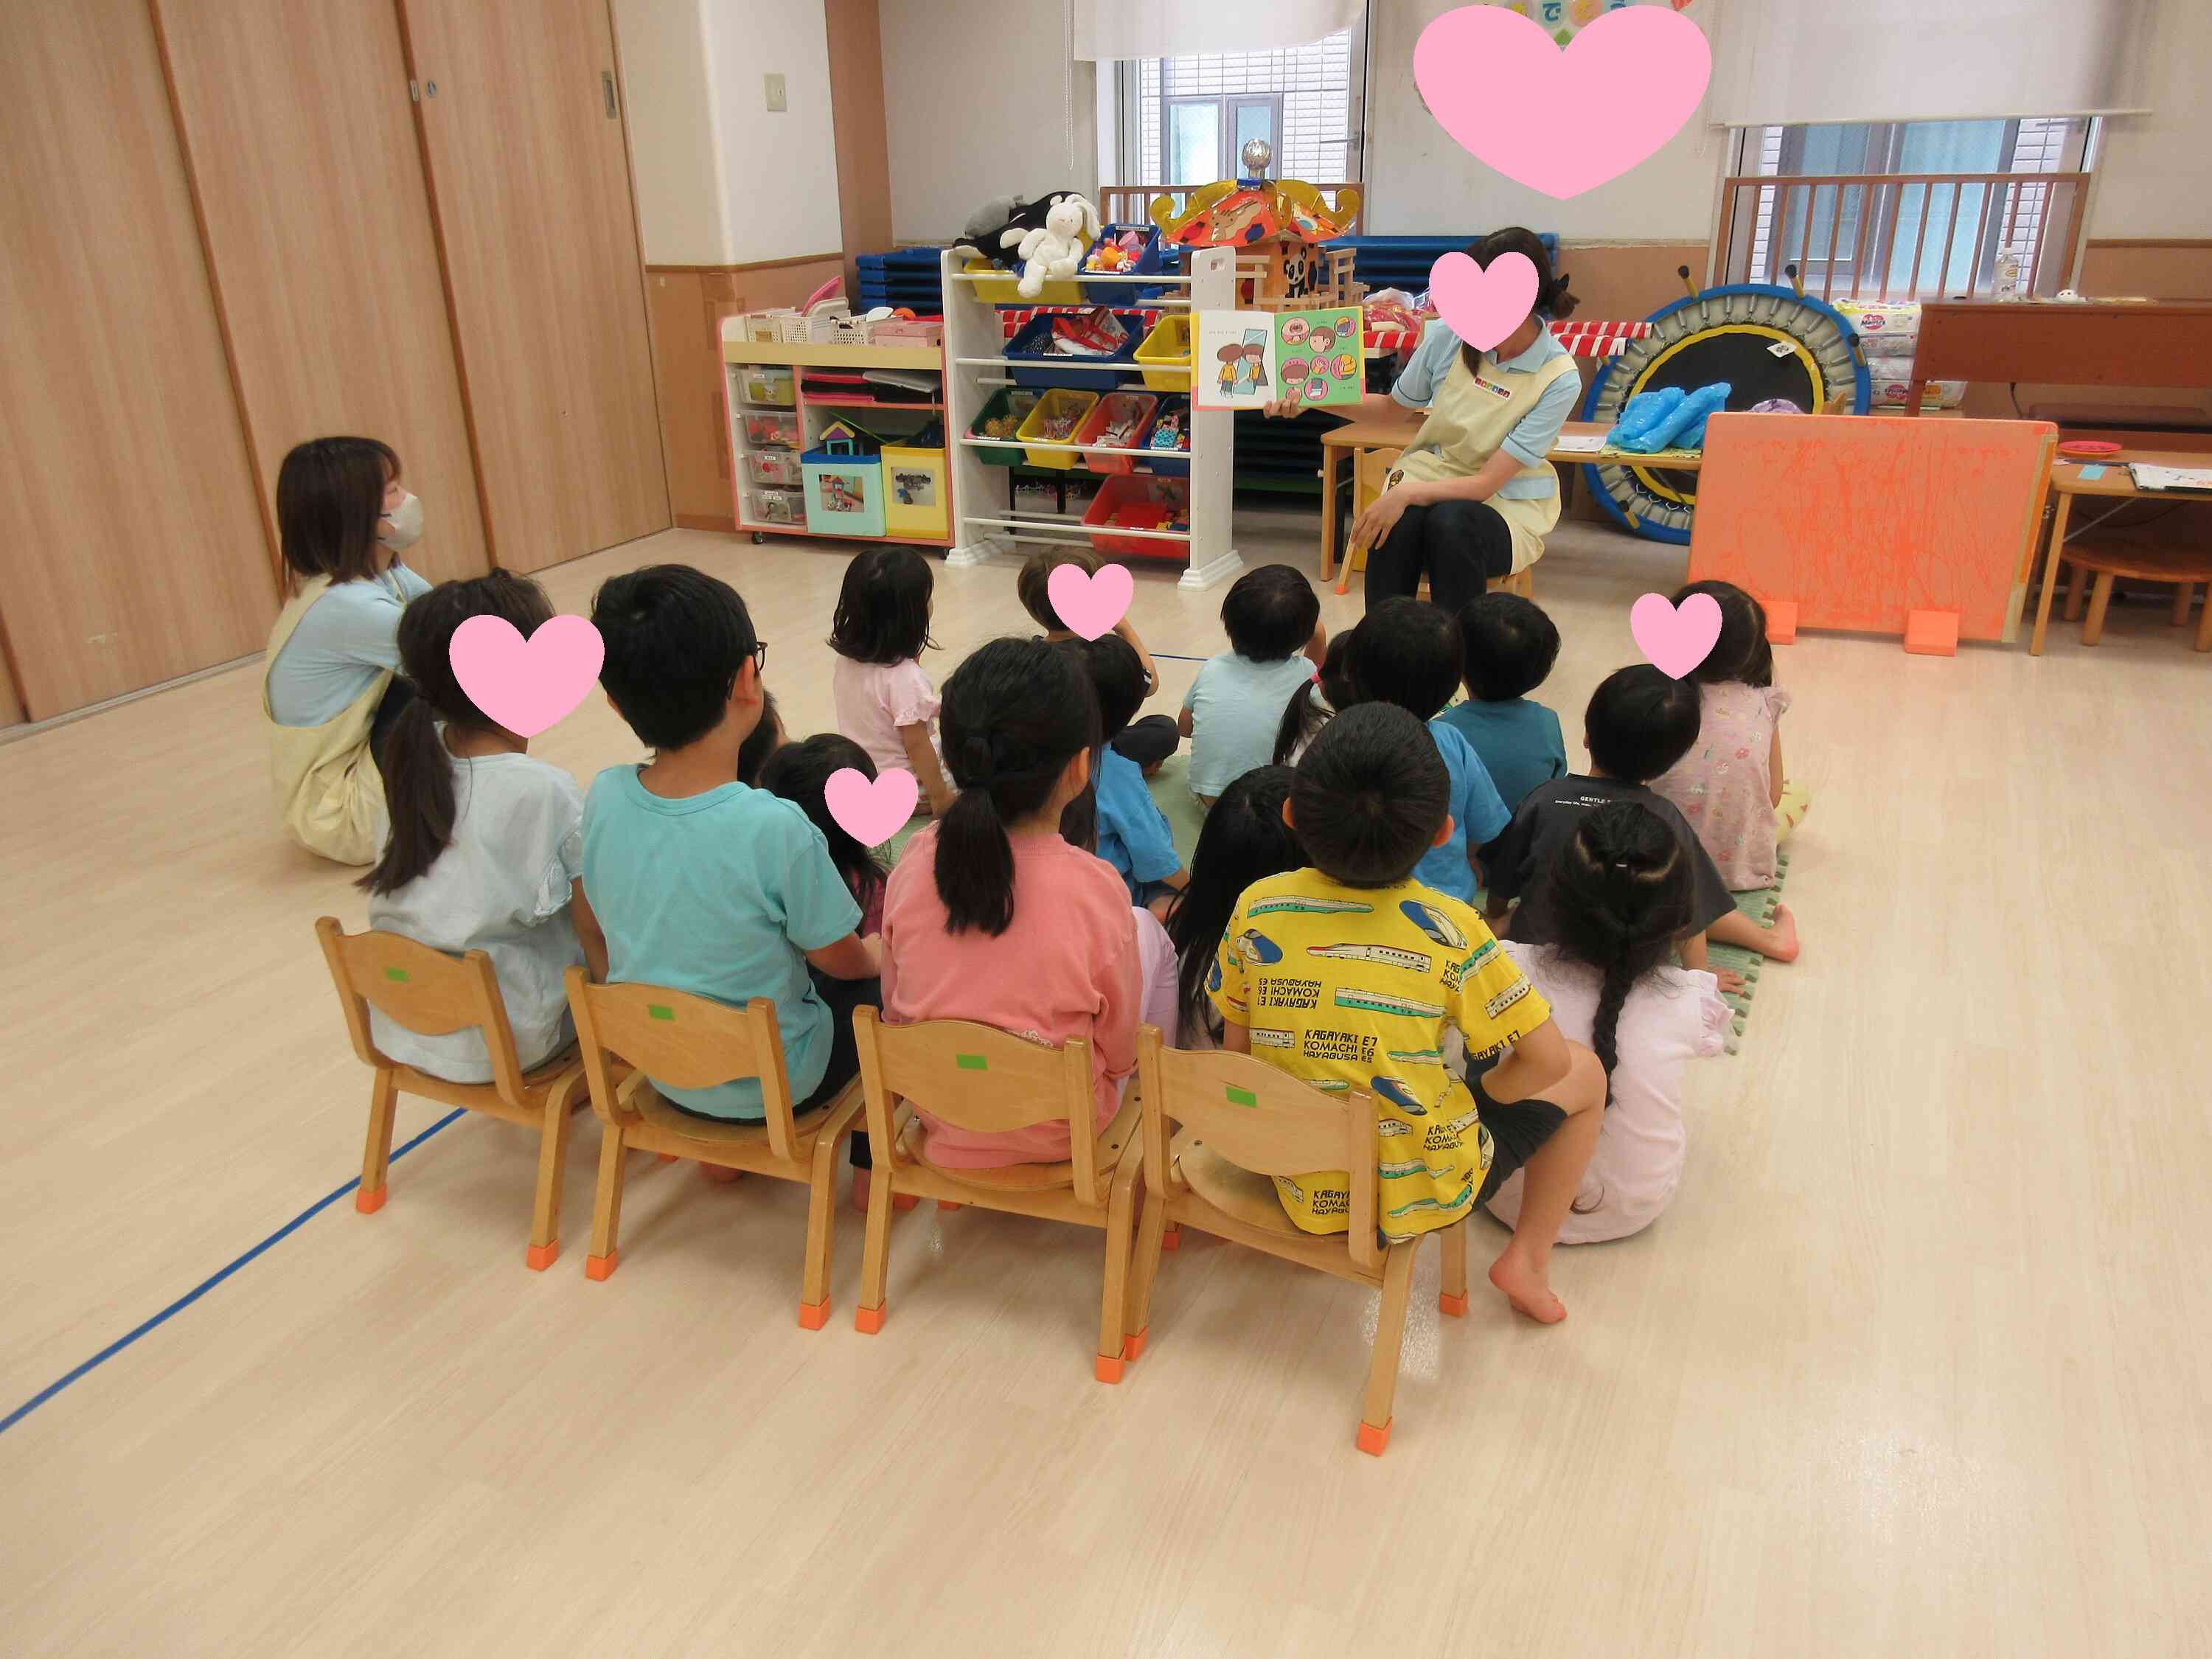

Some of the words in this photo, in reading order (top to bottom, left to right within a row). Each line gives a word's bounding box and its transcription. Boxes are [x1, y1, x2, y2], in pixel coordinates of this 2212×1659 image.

[1270, 978, 1322, 988] HAYABUSA
[1270, 986, 1320, 998] KOMACHI
[1268, 996, 1318, 1009] KAGAYAKI
[1304, 1029, 1359, 1044] KAGAYAKI
[1362, 1035, 1378, 1047] E7
[1304, 1040, 1357, 1054] KOMACHI
[1361, 1047, 1375, 1057] E6
[1303, 1049, 1358, 1062] HAYABUSA
